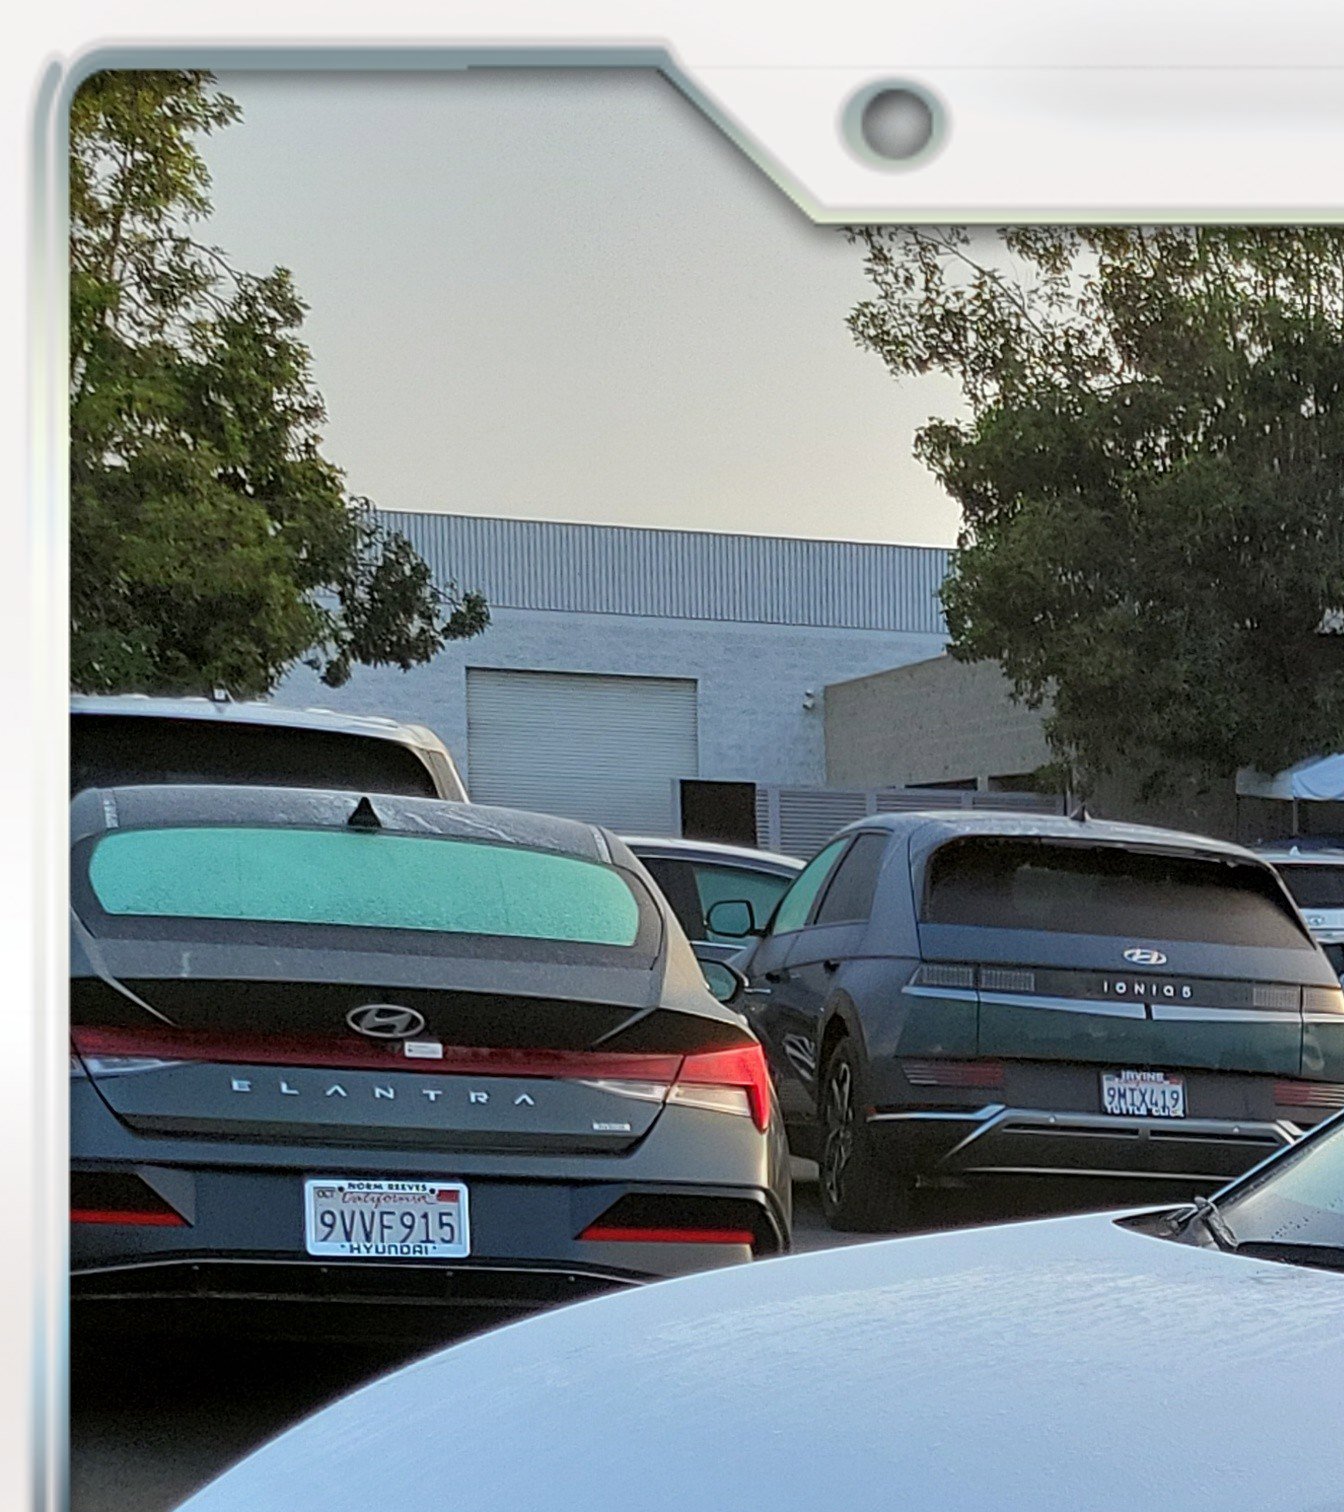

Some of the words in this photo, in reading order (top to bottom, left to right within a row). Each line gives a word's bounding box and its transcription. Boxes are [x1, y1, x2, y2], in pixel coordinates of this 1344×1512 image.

[231, 1079, 535, 1106] ELANTRA
[1106, 1086, 1180, 1109] 9MIX419
[347, 1182, 383, 1191] NORM
[387, 1182, 427, 1192] REEVES
[319, 1209, 455, 1244] 9VVF915
[350, 1244, 429, 1255] HYUNDAI
